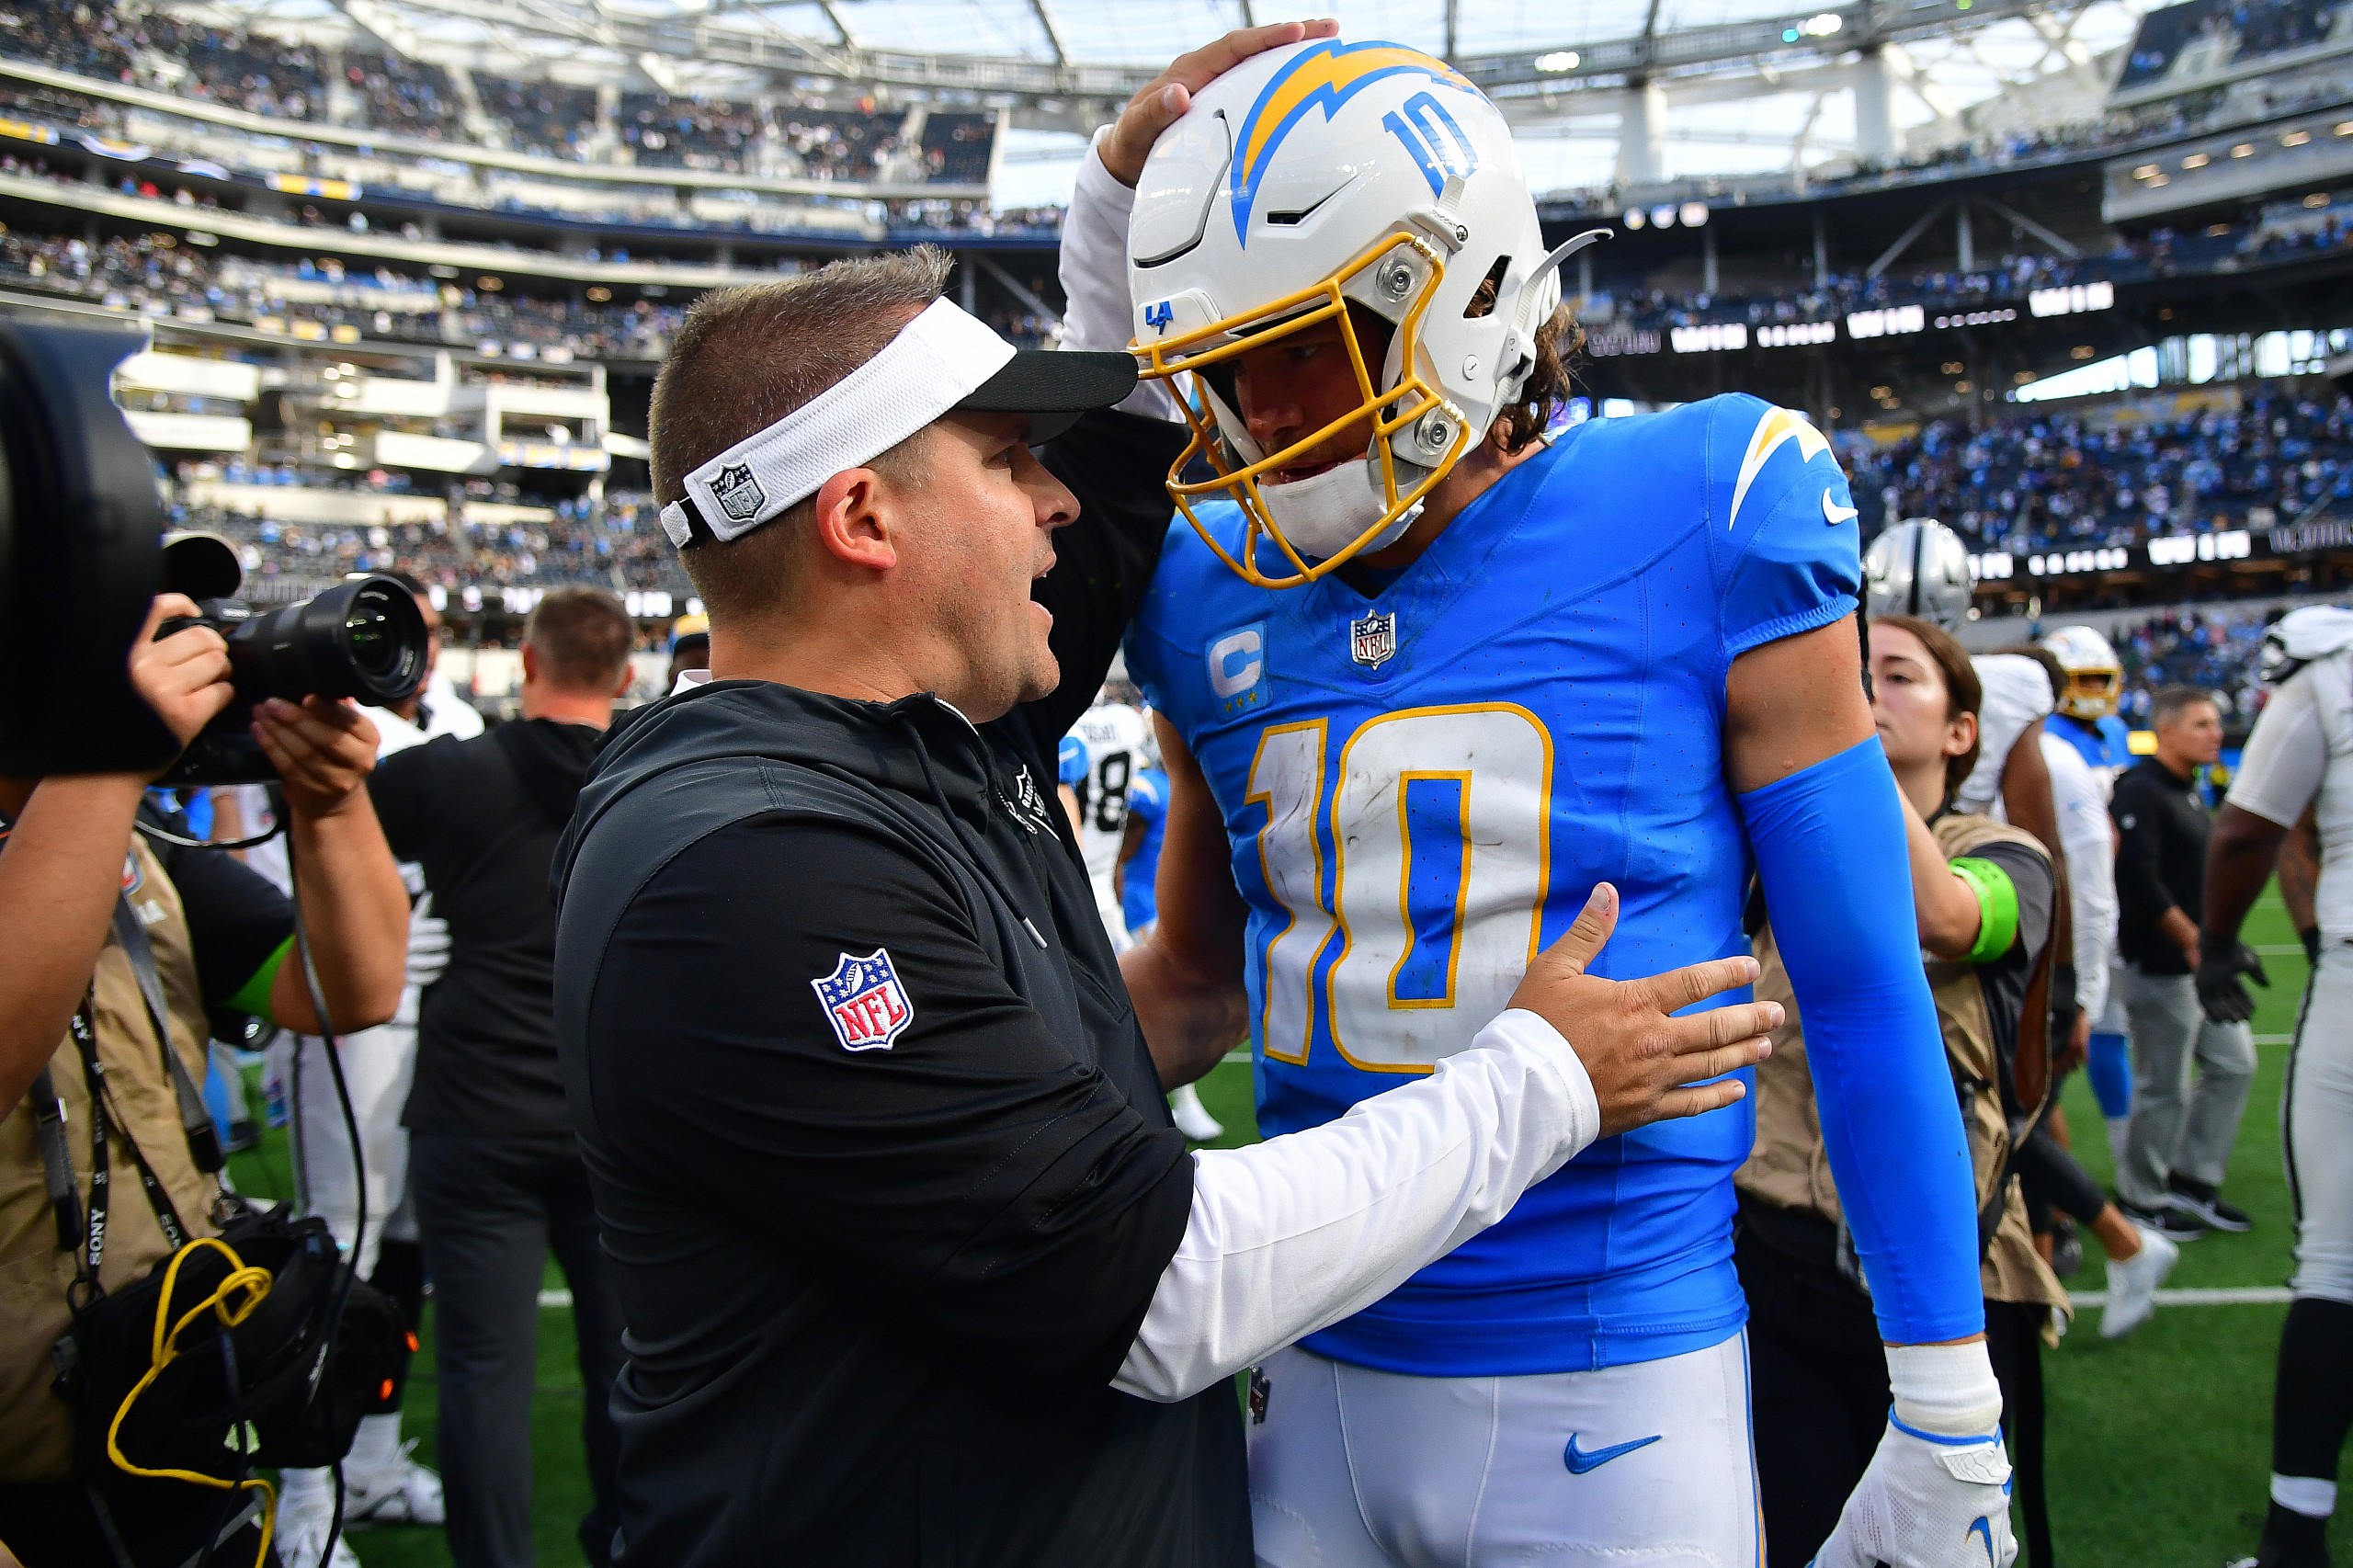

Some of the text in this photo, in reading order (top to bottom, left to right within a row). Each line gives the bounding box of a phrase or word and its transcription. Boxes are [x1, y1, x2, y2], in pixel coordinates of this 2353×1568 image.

[1381, 91, 1479, 200] 10
[722, 483, 764, 517] NFL
[1209, 631, 1261, 699] C
[1358, 632, 1388, 659] NFL
[1244, 700, 1554, 1074] 10
[835, 986, 905, 1041] NFL
[89, 1207, 106, 1266] SONY
[159, 1213, 184, 1251] SON
